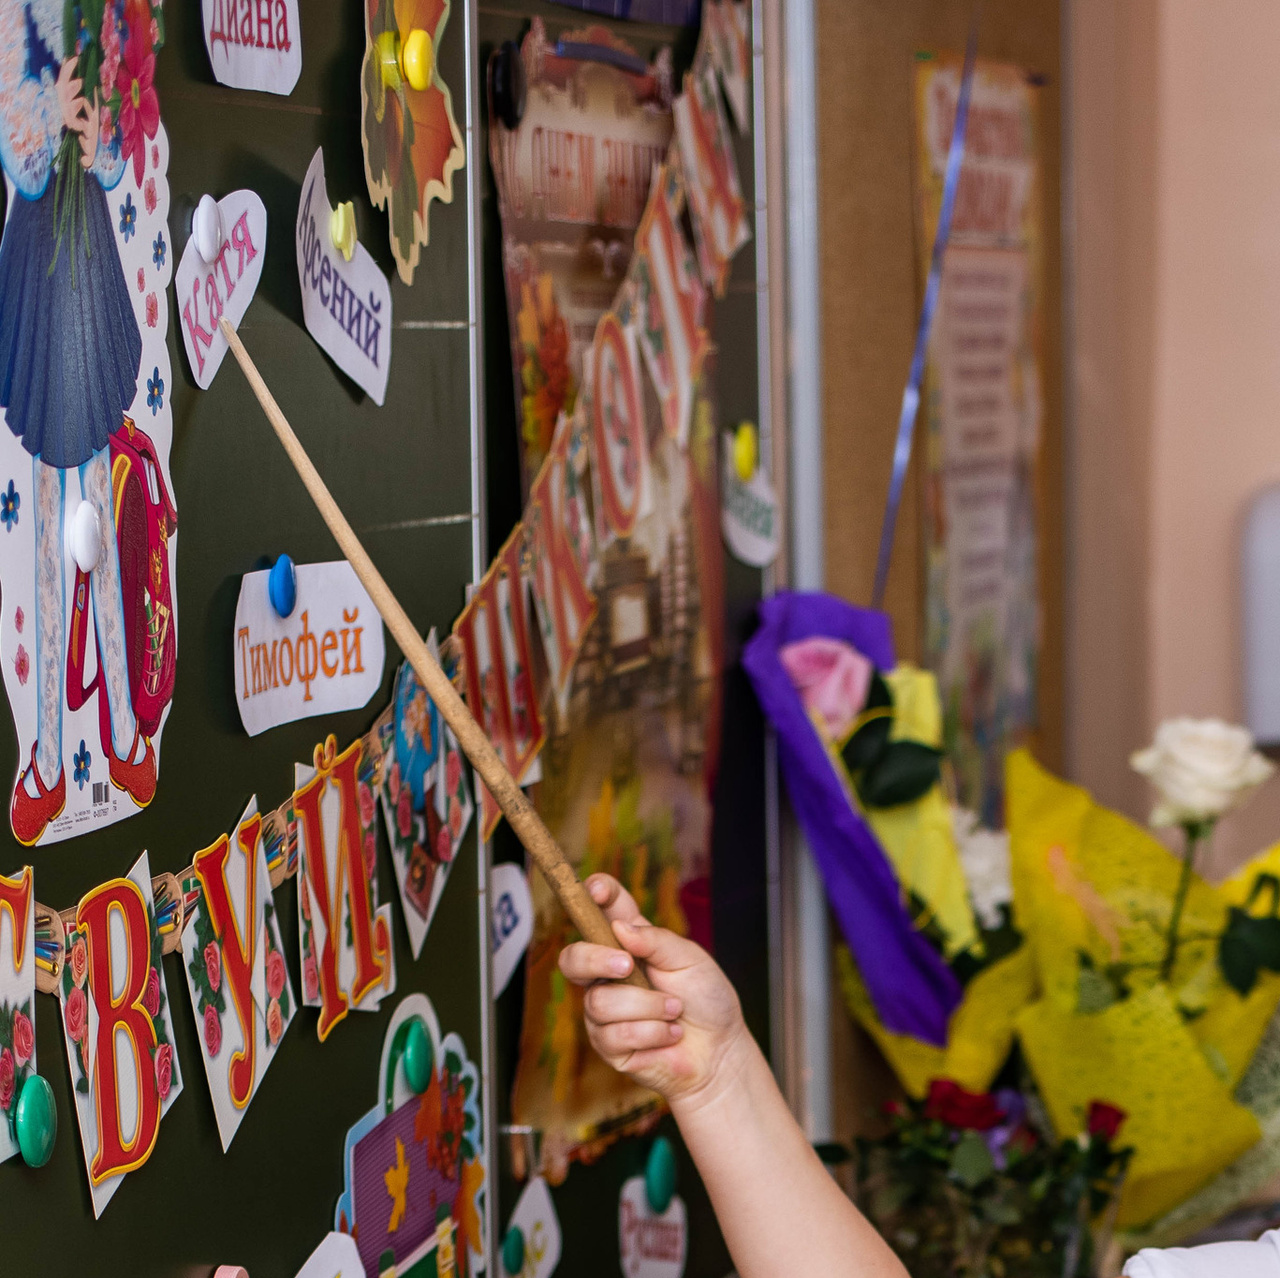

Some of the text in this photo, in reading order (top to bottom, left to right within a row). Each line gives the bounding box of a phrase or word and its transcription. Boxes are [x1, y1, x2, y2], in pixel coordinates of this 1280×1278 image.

[210, 0, 292, 64] Диана
[183, 210, 258, 377] Катя
[299, 177, 382, 368] Арсений
[238, 608, 364, 701] Тимофей
